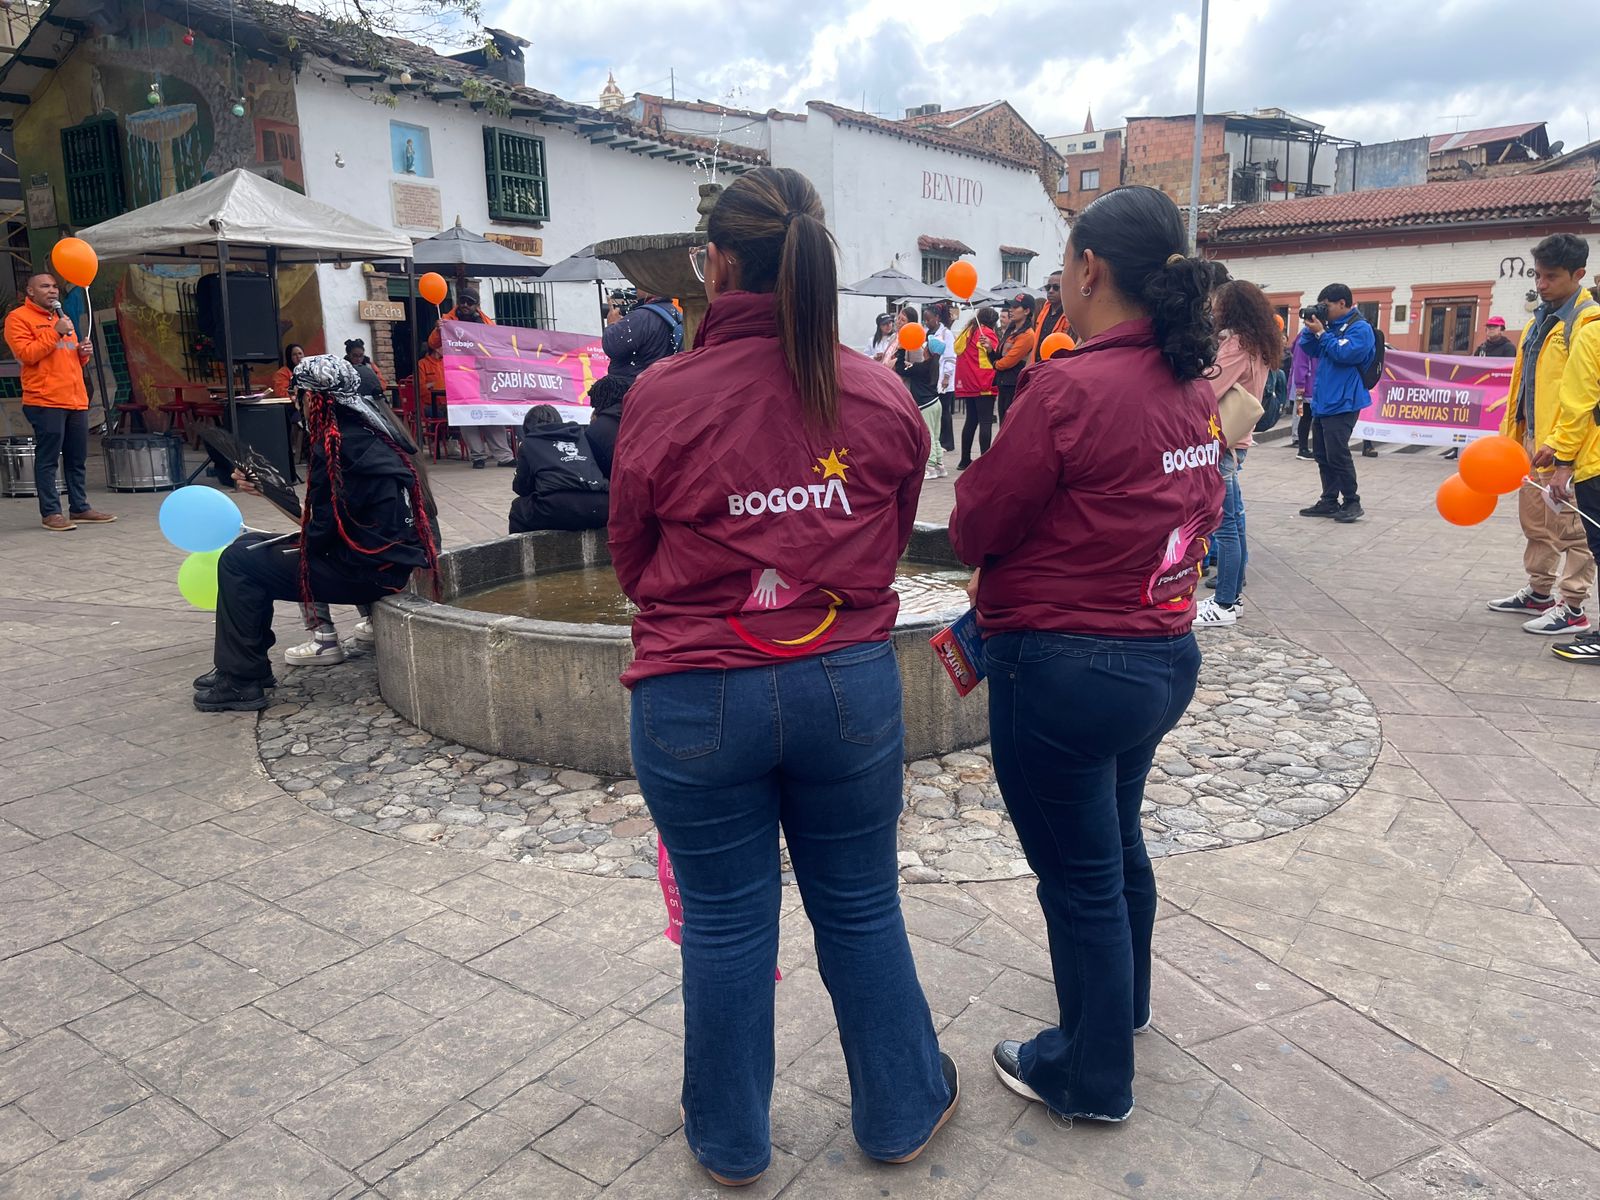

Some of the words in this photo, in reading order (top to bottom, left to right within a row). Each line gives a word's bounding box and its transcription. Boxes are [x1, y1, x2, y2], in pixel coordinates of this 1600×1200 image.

[921, 170, 983, 207] BENITO
[447, 340, 474, 349] Trabajo
[491, 369, 536, 393] ¿SABÍAS
[539, 374, 563, 390] QUE?
[1386, 387, 1404, 404] ¡NO
[1406, 387, 1450, 404] PERMITO
[1455, 390, 1471, 406] YO,
[1381, 403, 1397, 417] NO
[1398, 404, 1449, 421] PERMITAS
[1452, 405, 1470, 422] TÚ!
[946, 649, 963, 678] RUTA
